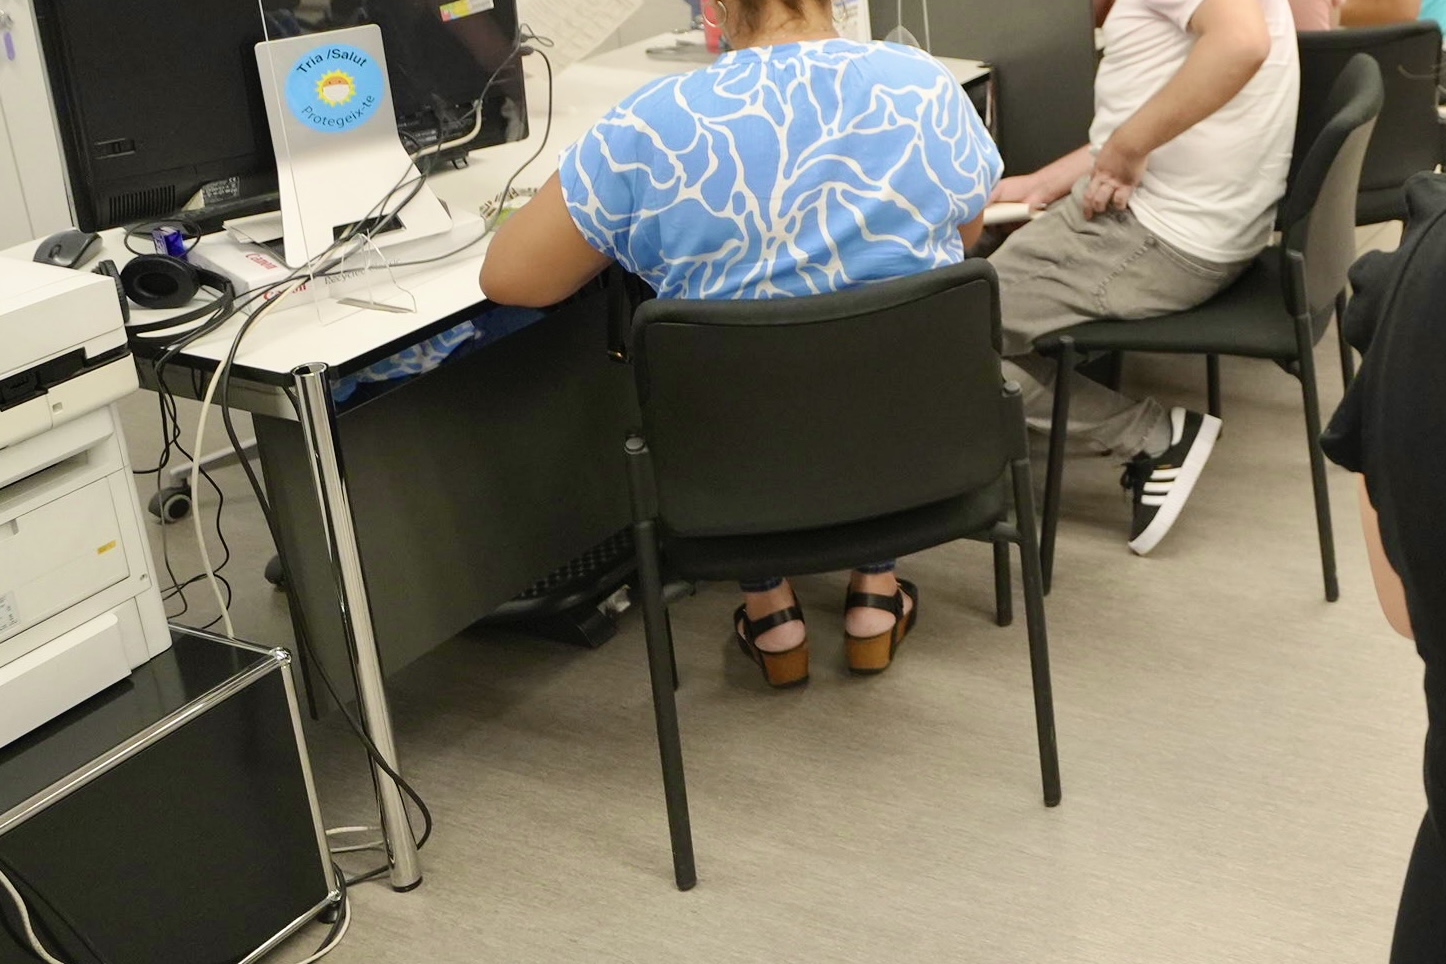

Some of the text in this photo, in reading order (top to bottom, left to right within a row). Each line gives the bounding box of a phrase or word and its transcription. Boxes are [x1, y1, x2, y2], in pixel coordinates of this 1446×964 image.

[296, 54, 323, 73] Tria
[301, 95, 375, 128] Protegeix-te
[245, 253, 278, 270] Canon
